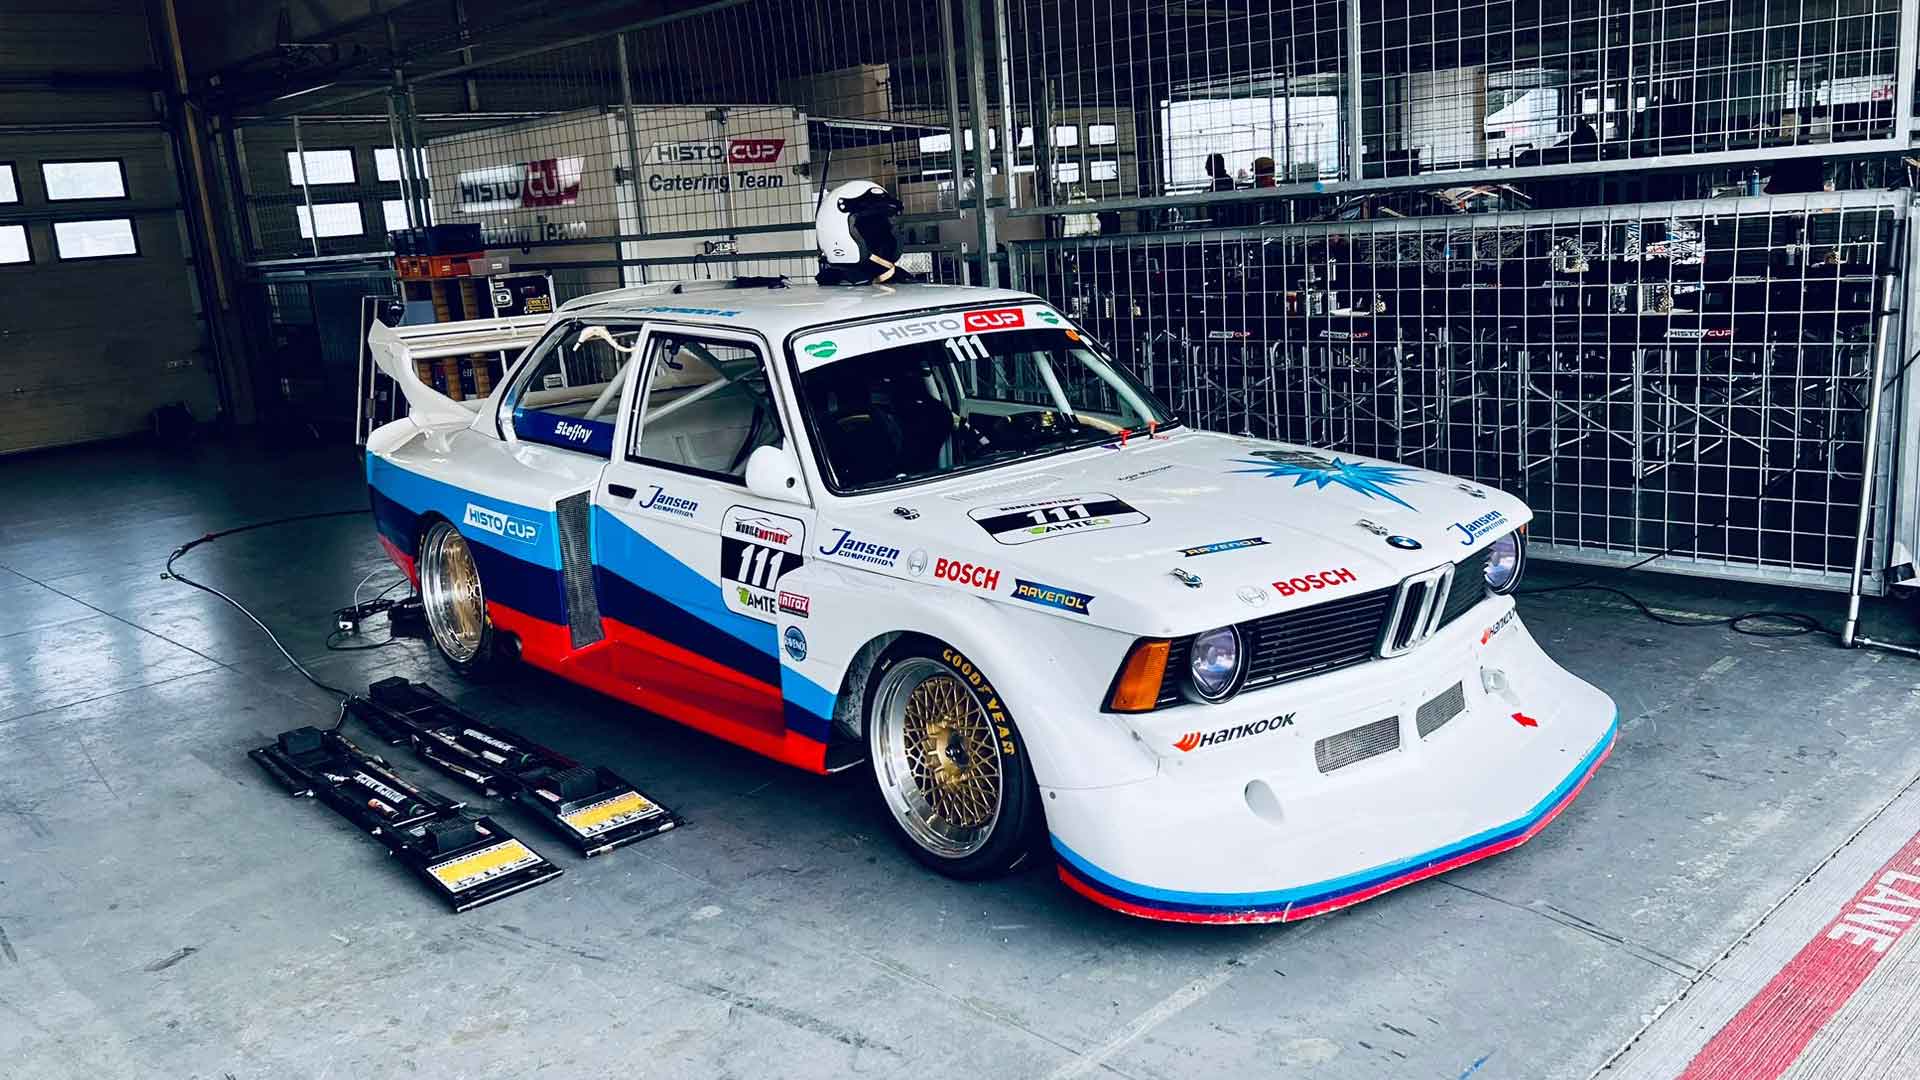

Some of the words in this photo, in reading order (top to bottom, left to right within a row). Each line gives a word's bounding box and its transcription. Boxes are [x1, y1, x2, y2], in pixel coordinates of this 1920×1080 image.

[657, 144, 723, 161] HISTO
[731, 144, 777, 159] CUP
[648, 174, 731, 192] Catering
[737, 172, 784, 188] Team
[878, 319, 960, 341] HISTO
[967, 313, 1020, 328] CUP
[945, 334, 990, 362] 111
[555, 421, 592, 443] Steffny
[640, 485, 698, 511] Jansen
[470, 508, 503, 531] HISTO
[507, 521, 536, 538] CUP
[1027, 504, 1090, 525] 111
[1446, 510, 1502, 546] Jansen
[819, 528, 901, 560] Jansen
[1186, 540, 1262, 555] RAVENOL
[738, 543, 784, 591] 111
[838, 549, 895, 568] COMPETITION
[934, 557, 1001, 591] BOSCH
[1272, 567, 1357, 597] BOSCH
[1018, 584, 1085, 609] RAVENOL
[943, 649, 1015, 755] GOODYEAR
[1199, 712, 1297, 748] Hankook
[1826, 870, 1920, 953] LANE
